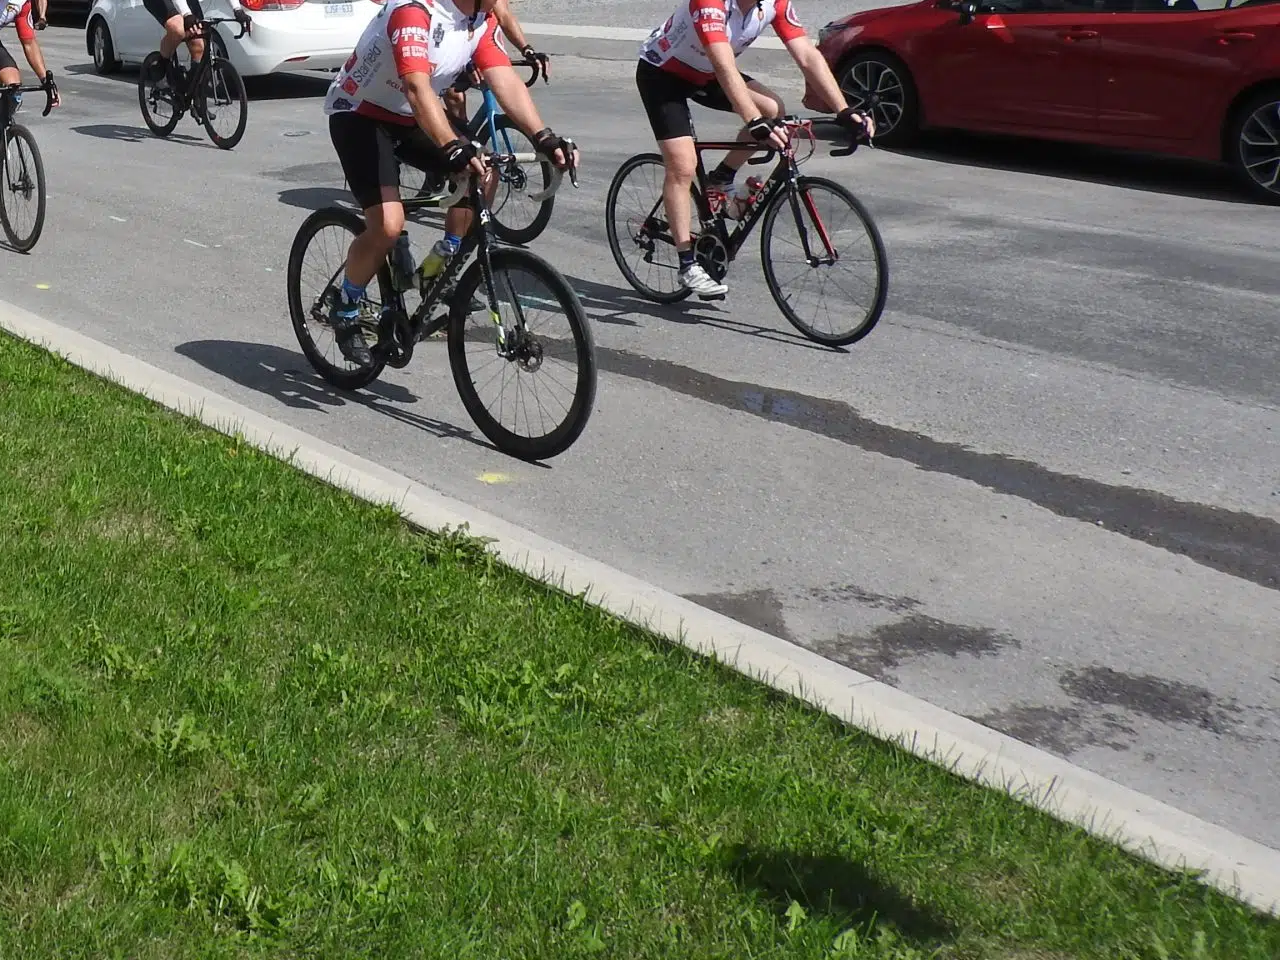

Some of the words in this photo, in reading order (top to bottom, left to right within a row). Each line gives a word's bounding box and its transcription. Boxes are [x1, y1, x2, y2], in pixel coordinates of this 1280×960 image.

[352, 44, 382, 83] Starfield
[739, 214, 752, 231] DE
[751, 179, 776, 212] ROSA
